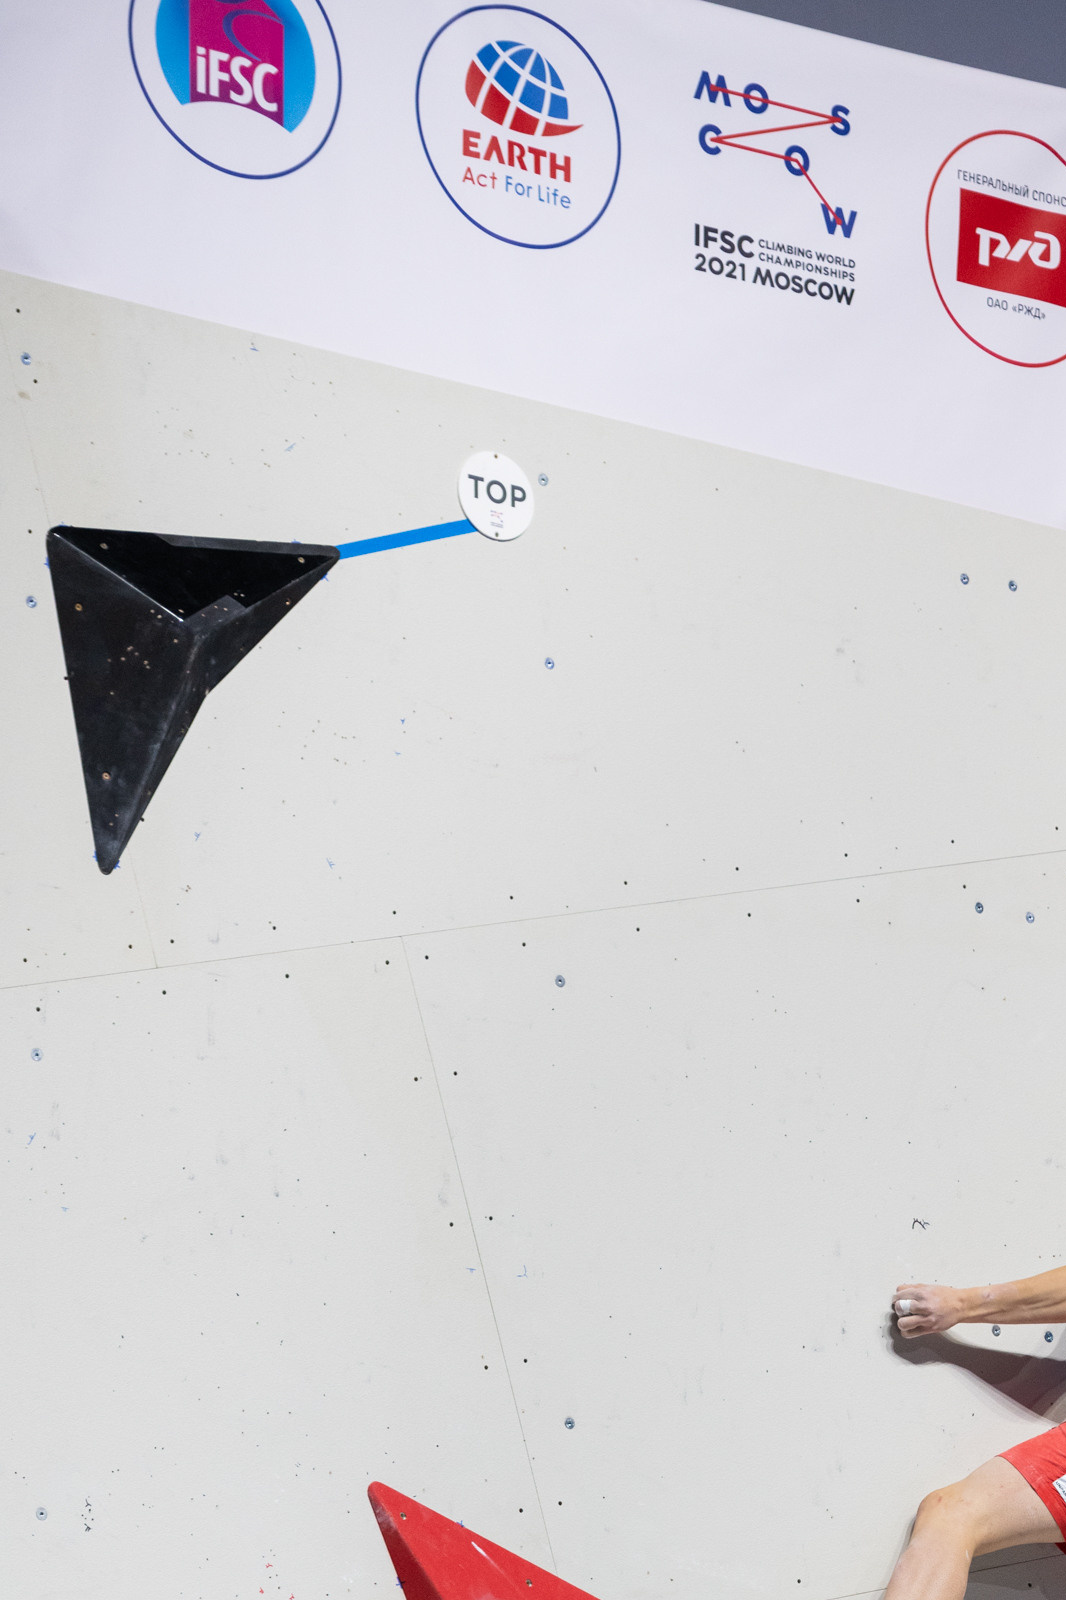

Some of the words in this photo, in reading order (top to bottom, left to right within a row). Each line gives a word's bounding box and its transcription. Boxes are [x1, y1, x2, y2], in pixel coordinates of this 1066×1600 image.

[462, 129, 571, 183] EARTH
[462, 166, 498, 190] Act
[505, 175, 533, 200] For
[537, 183, 571, 210] Life
[957, 169, 1030, 199] ГЕНЕРАЛЬНЫЙ
[694, 223, 755, 258] IFSC
[758, 239, 813, 259] CLIMBING
[815, 251, 856, 269] WORLD
[695, 253, 746, 281] 2021
[752, 266, 855, 306] MOSCOW
[758, 252, 856, 282] CHAMPIONSHIPS
[986, 296, 1009, 312] ОАО
[1012, 302, 1046, 321] «РЖД»
[468, 474, 526, 508] TOP
